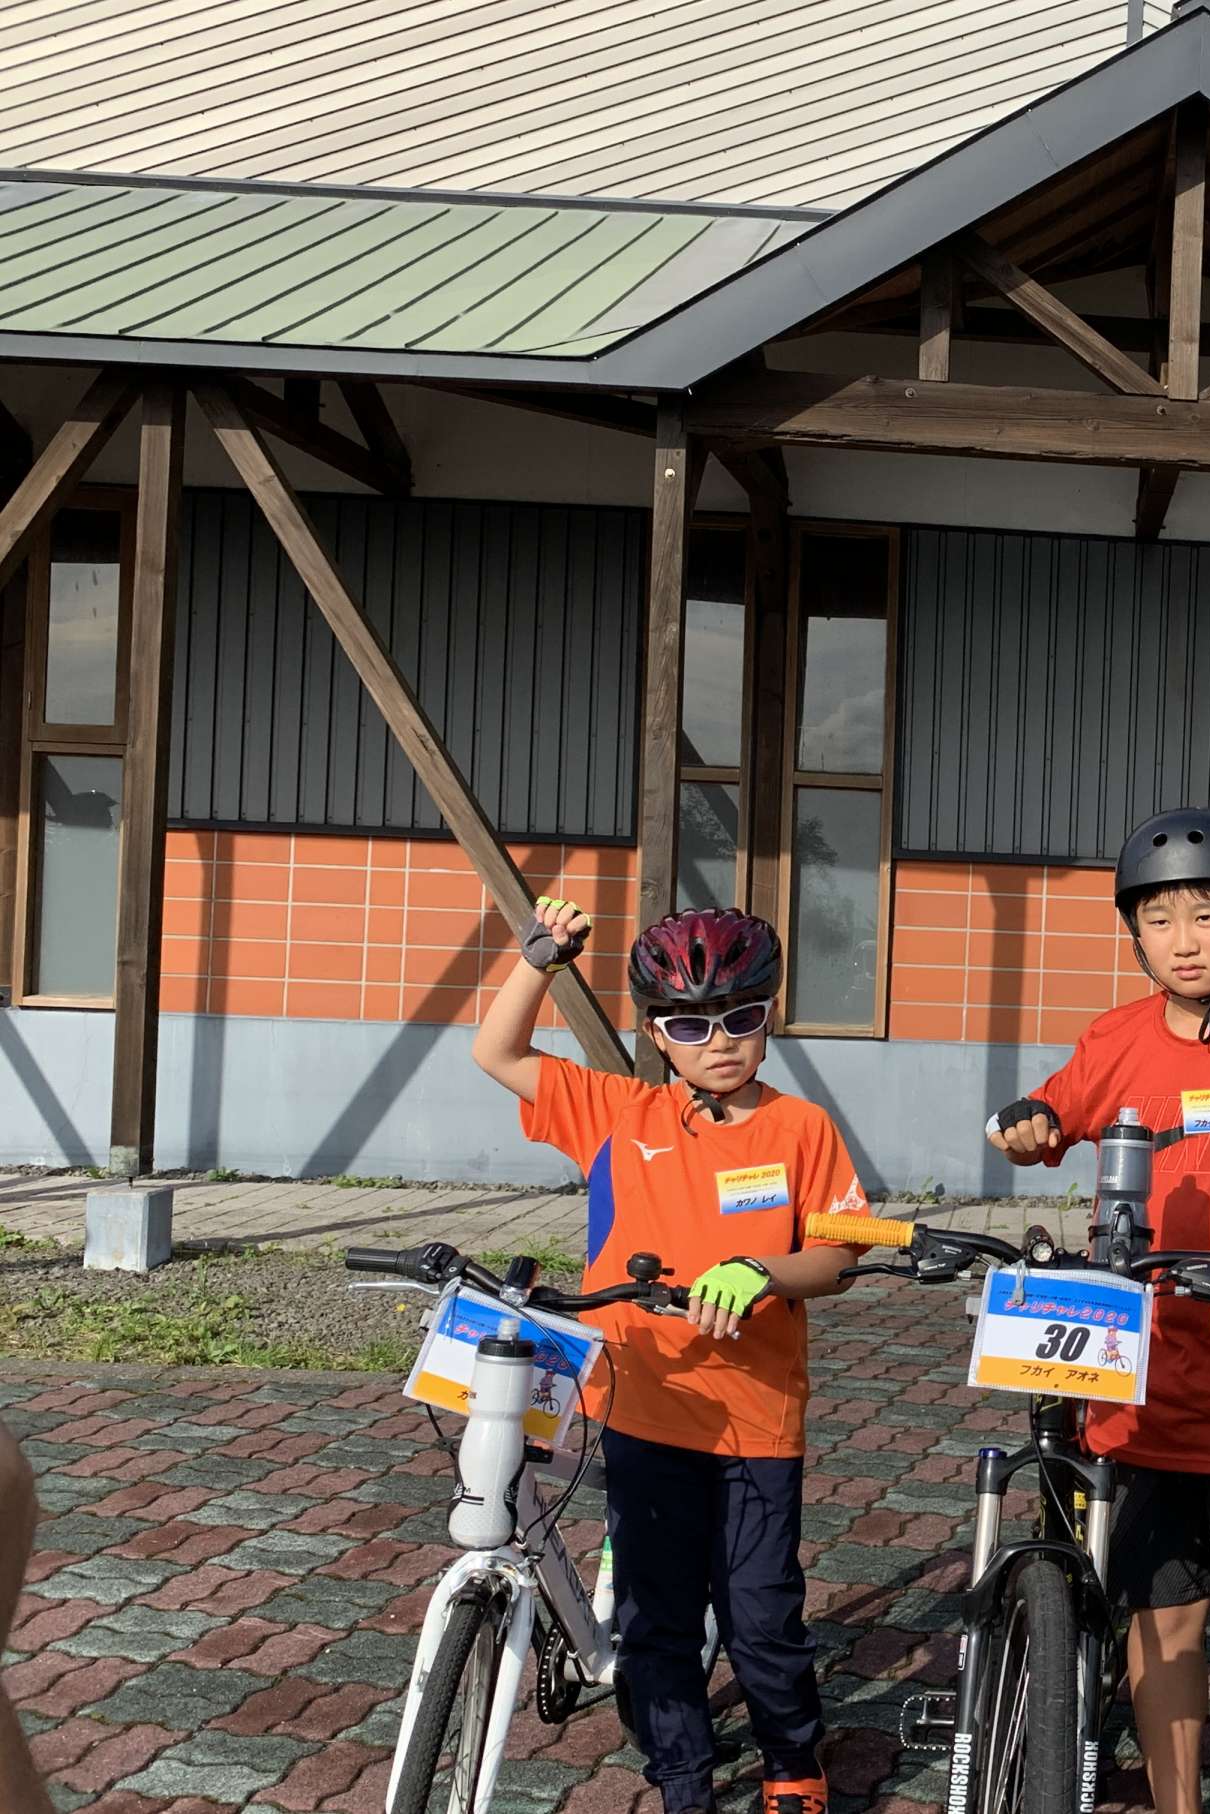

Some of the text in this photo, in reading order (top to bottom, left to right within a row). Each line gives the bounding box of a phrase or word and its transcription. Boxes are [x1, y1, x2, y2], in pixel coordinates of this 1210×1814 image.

[760, 1168, 781, 1179] 2020
[735, 1194, 777, 1208] カワノ レイ
[1035, 1323, 1091, 1362] 30
[1020, 1364, 1100, 1383] フカイ アオネ
[1079, 1740, 1100, 1814] OCKSHOX
